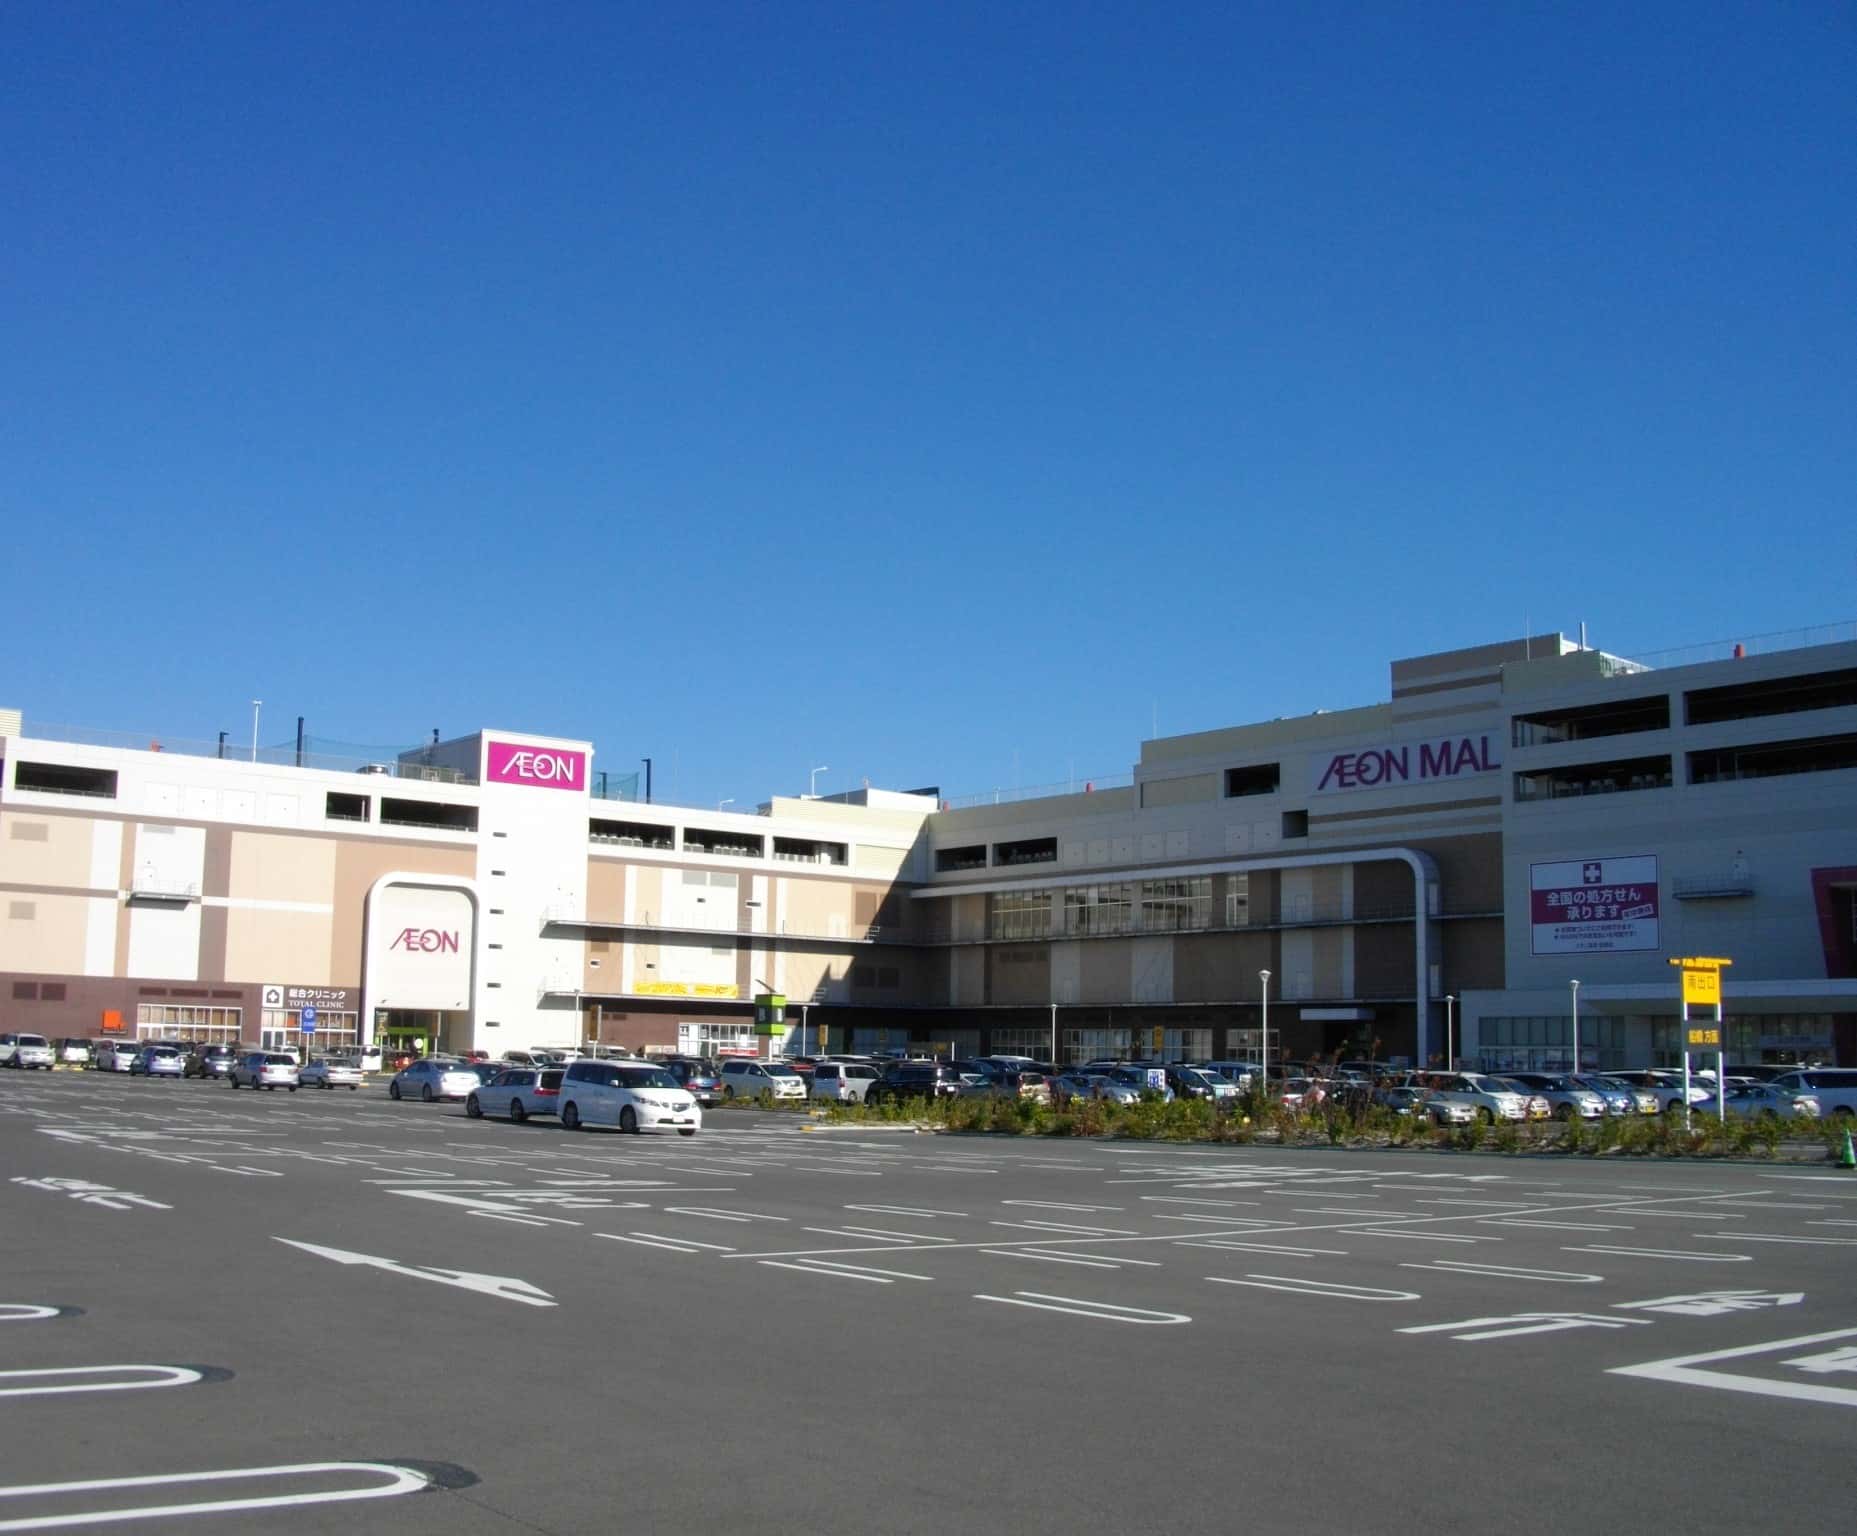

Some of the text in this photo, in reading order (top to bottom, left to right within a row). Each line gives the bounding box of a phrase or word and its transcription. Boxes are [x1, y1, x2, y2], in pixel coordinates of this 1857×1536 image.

[1546, 887, 1641, 906] 全国の処方せん
[1567, 904, 1620, 920] 承ります
[288, 988, 346, 999] 総合クリニック
[288, 999, 345, 1009] TOTAL CLINIC
